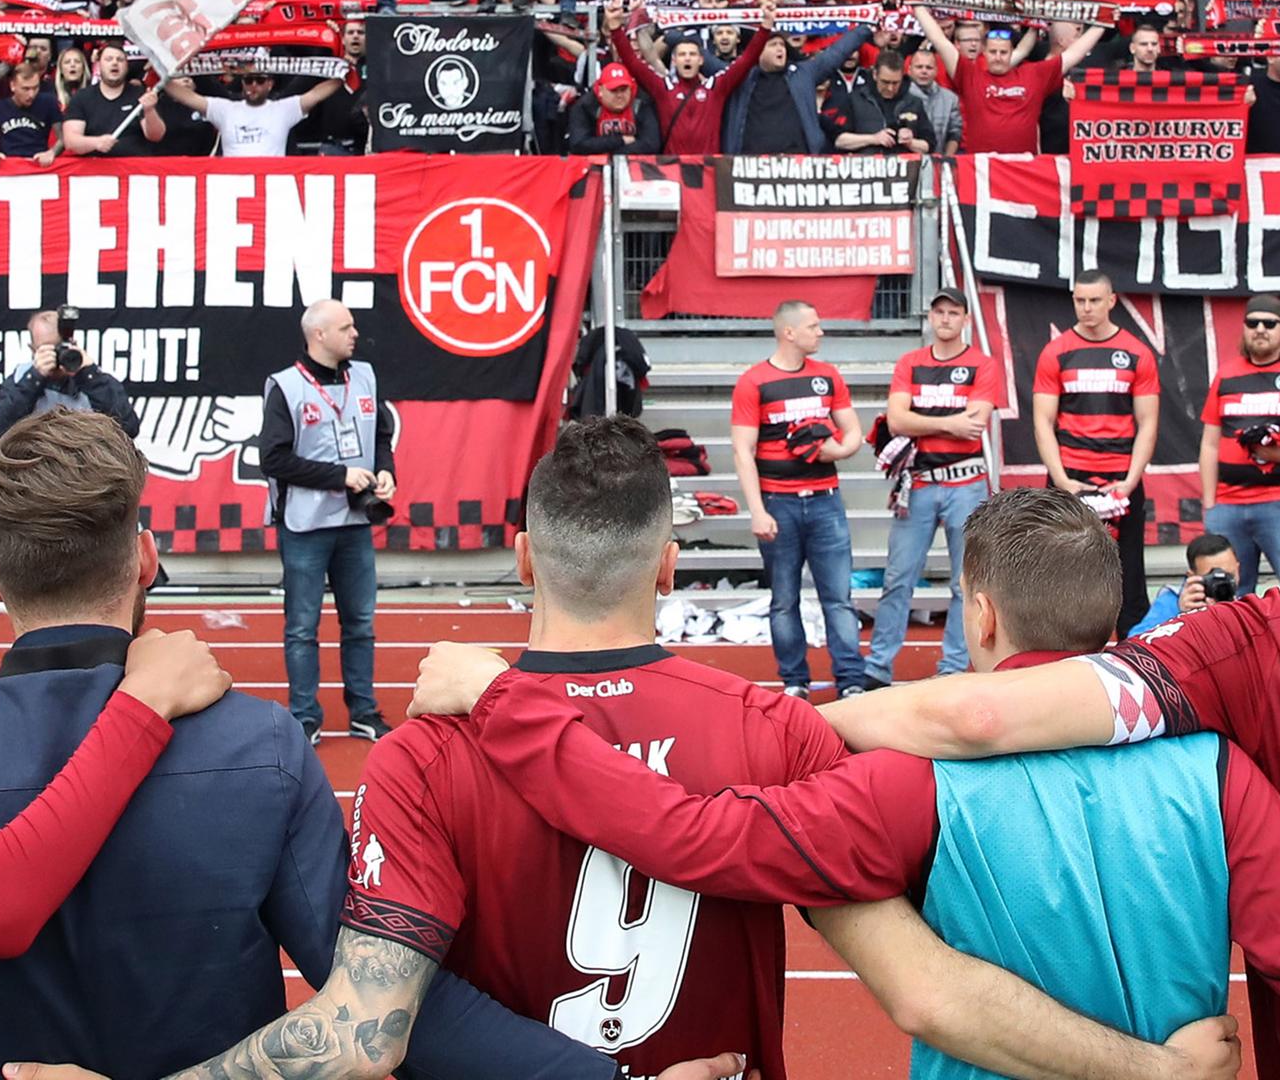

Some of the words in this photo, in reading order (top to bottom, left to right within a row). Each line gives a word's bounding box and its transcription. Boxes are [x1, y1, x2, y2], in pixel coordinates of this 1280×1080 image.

[69, 21, 124, 37] NÜRNB
[393, 22, 500, 55] Thodoris
[379, 102, 418, 129] In
[420, 107, 522, 140] memoriam
[1074, 120, 1242, 139] NORDKURVE
[1083, 139, 1234, 162] NÜRNBERG
[733, 181, 910, 207] BANNMEILE
[458, 207, 496, 259] 1.
[753, 217, 892, 241] DURCHHALTEN
[752, 247, 778, 269] NO
[783, 245, 893, 268] SURRENDER
[419, 259, 537, 316] FCN
[565, 682, 596, 700] Der
[595, 678, 634, 698] Club
[549, 844, 703, 1054] 9
